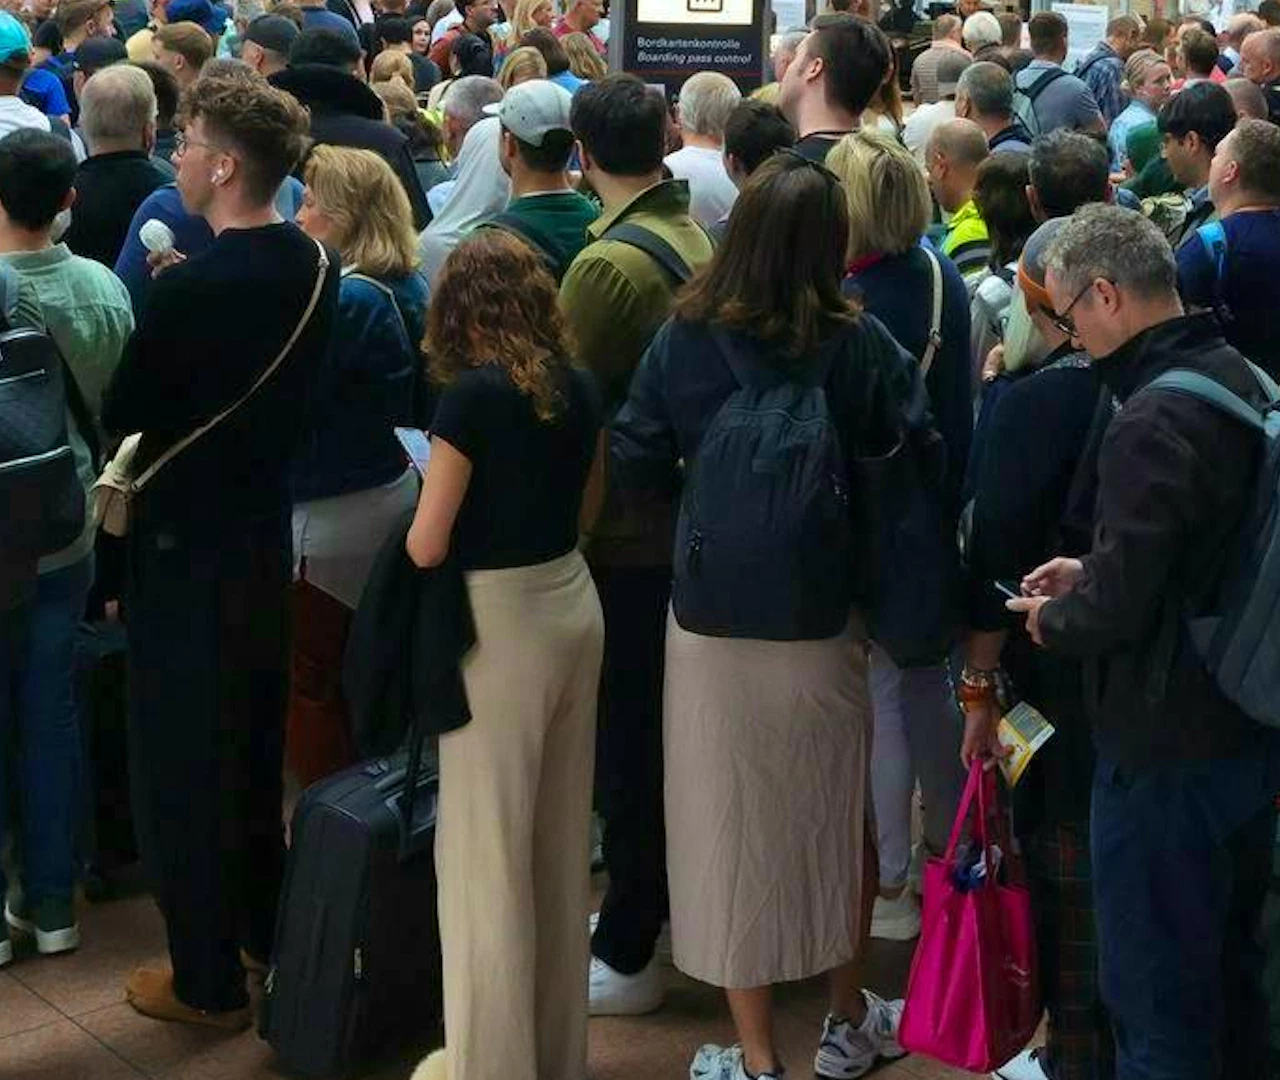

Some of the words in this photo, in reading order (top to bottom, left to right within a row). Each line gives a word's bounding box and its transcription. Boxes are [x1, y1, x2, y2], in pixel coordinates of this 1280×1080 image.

[636, 36, 741, 50] Bordkartenkontrolle
[637, 51, 686, 65] Boarding
[686, 53, 712, 64] pass
[714, 53, 752, 65] control
